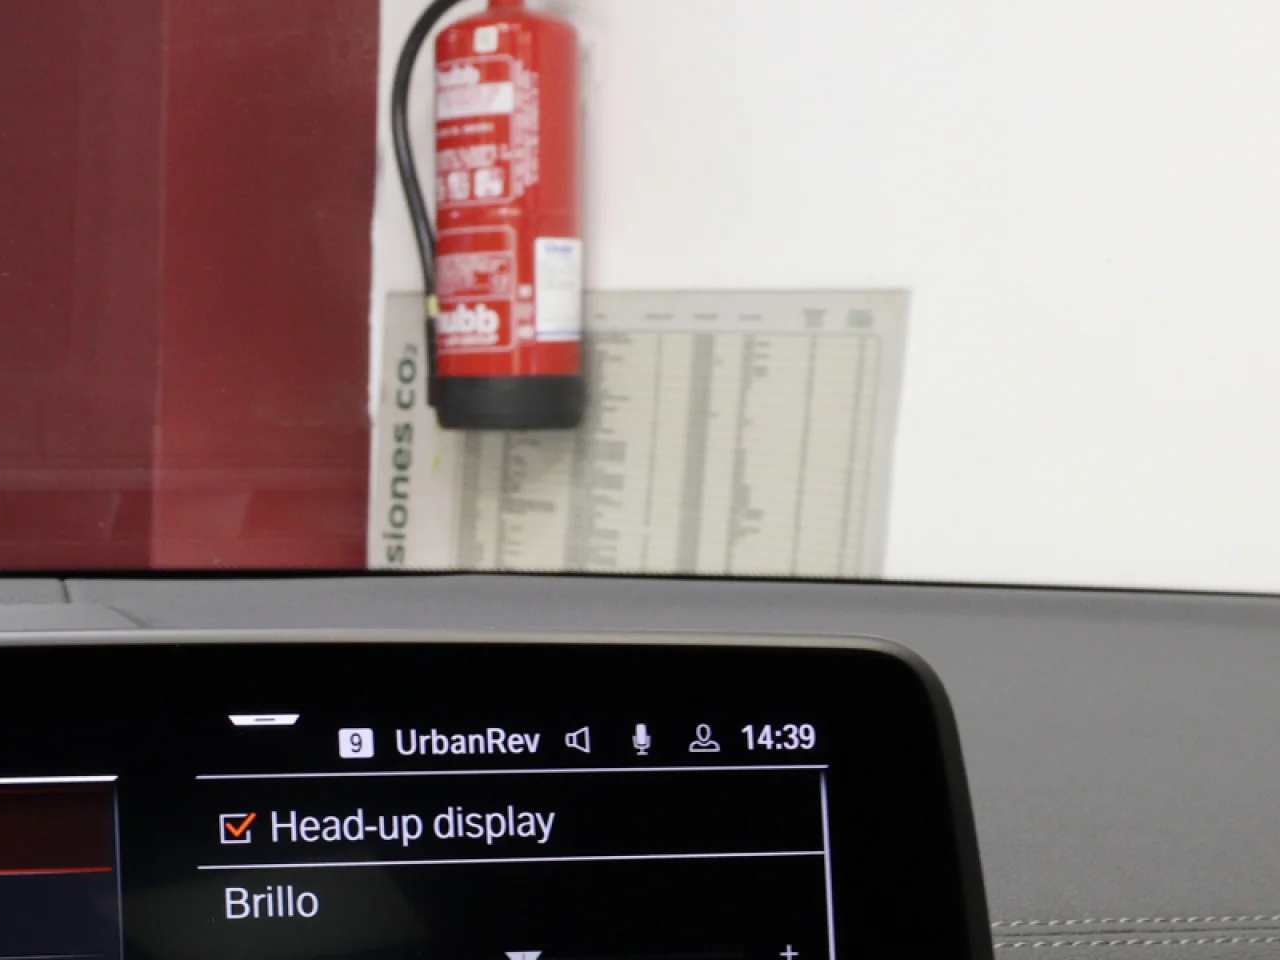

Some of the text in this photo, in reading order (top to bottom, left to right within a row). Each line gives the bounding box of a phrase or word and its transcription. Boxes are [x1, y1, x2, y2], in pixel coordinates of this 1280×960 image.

[349, 723, 817, 756] 9 UrbanRev 14:39
[271, 804, 557, 848] Head-up display
[224, 885, 320, 920] Brillo
